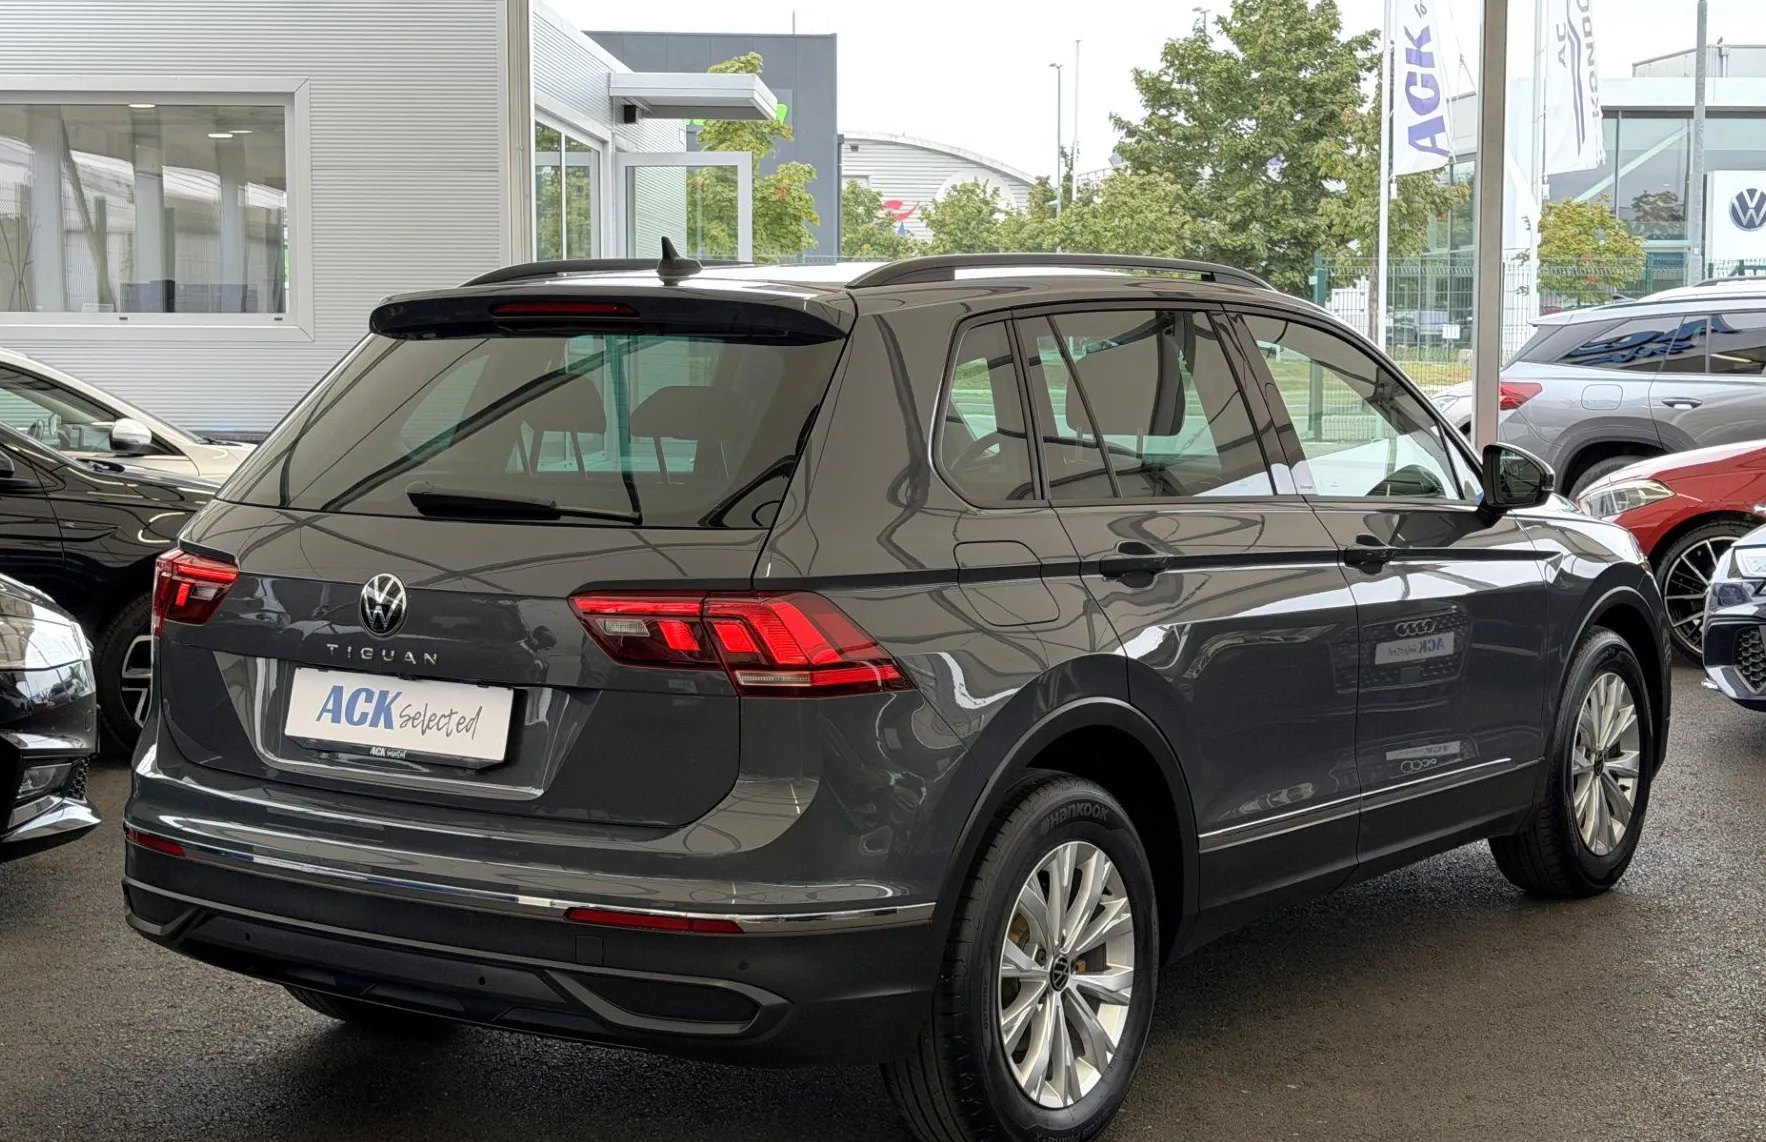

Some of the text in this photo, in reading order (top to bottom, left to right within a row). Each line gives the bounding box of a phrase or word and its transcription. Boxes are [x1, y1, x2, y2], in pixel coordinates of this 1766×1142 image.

[1404, 25, 1449, 158] ACK
[326, 643, 438, 665] TIGUAN
[316, 685, 402, 730] ACK
[370, 746, 386, 757] ACK
